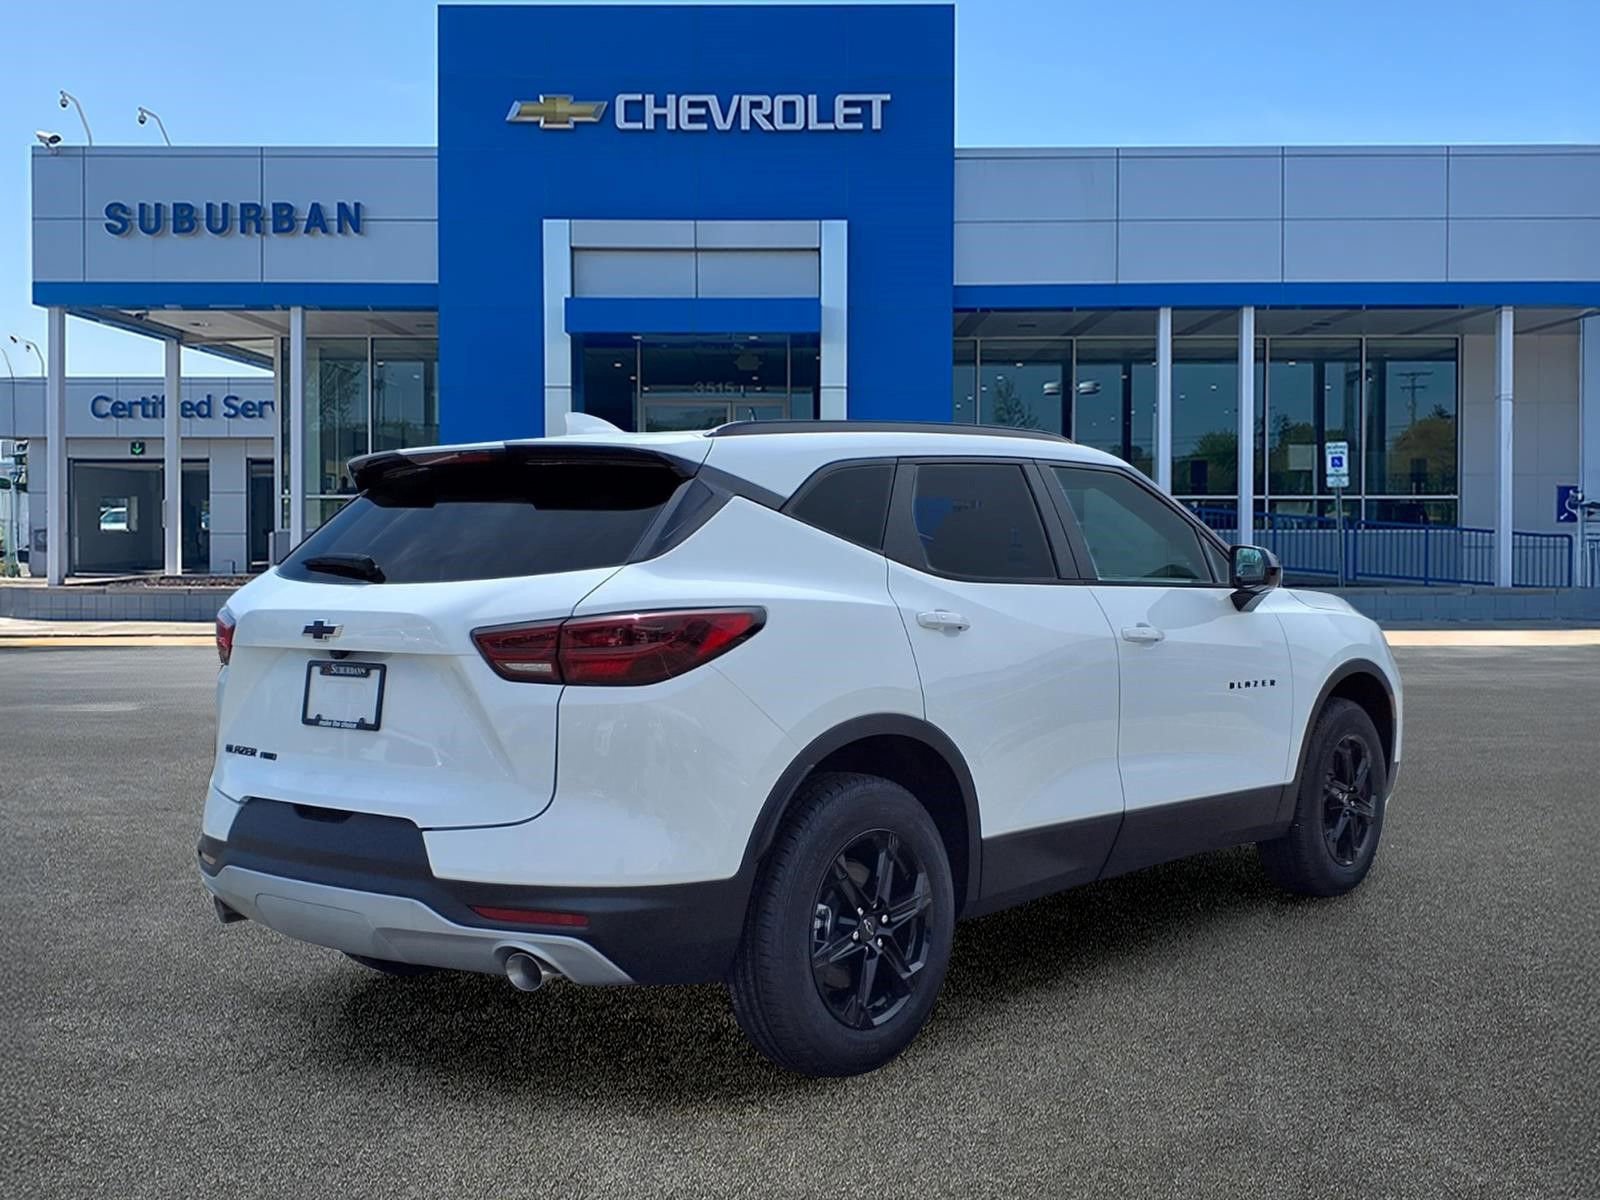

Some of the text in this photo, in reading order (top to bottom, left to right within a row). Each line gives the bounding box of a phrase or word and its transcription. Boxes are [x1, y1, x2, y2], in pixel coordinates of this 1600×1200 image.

[614, 93, 892, 132] CHEVROLET
[104, 201, 362, 236] SUBURBAN
[91, 395, 275, 419] Certifed Ser
[1229, 680, 1276, 689] BLAZER
